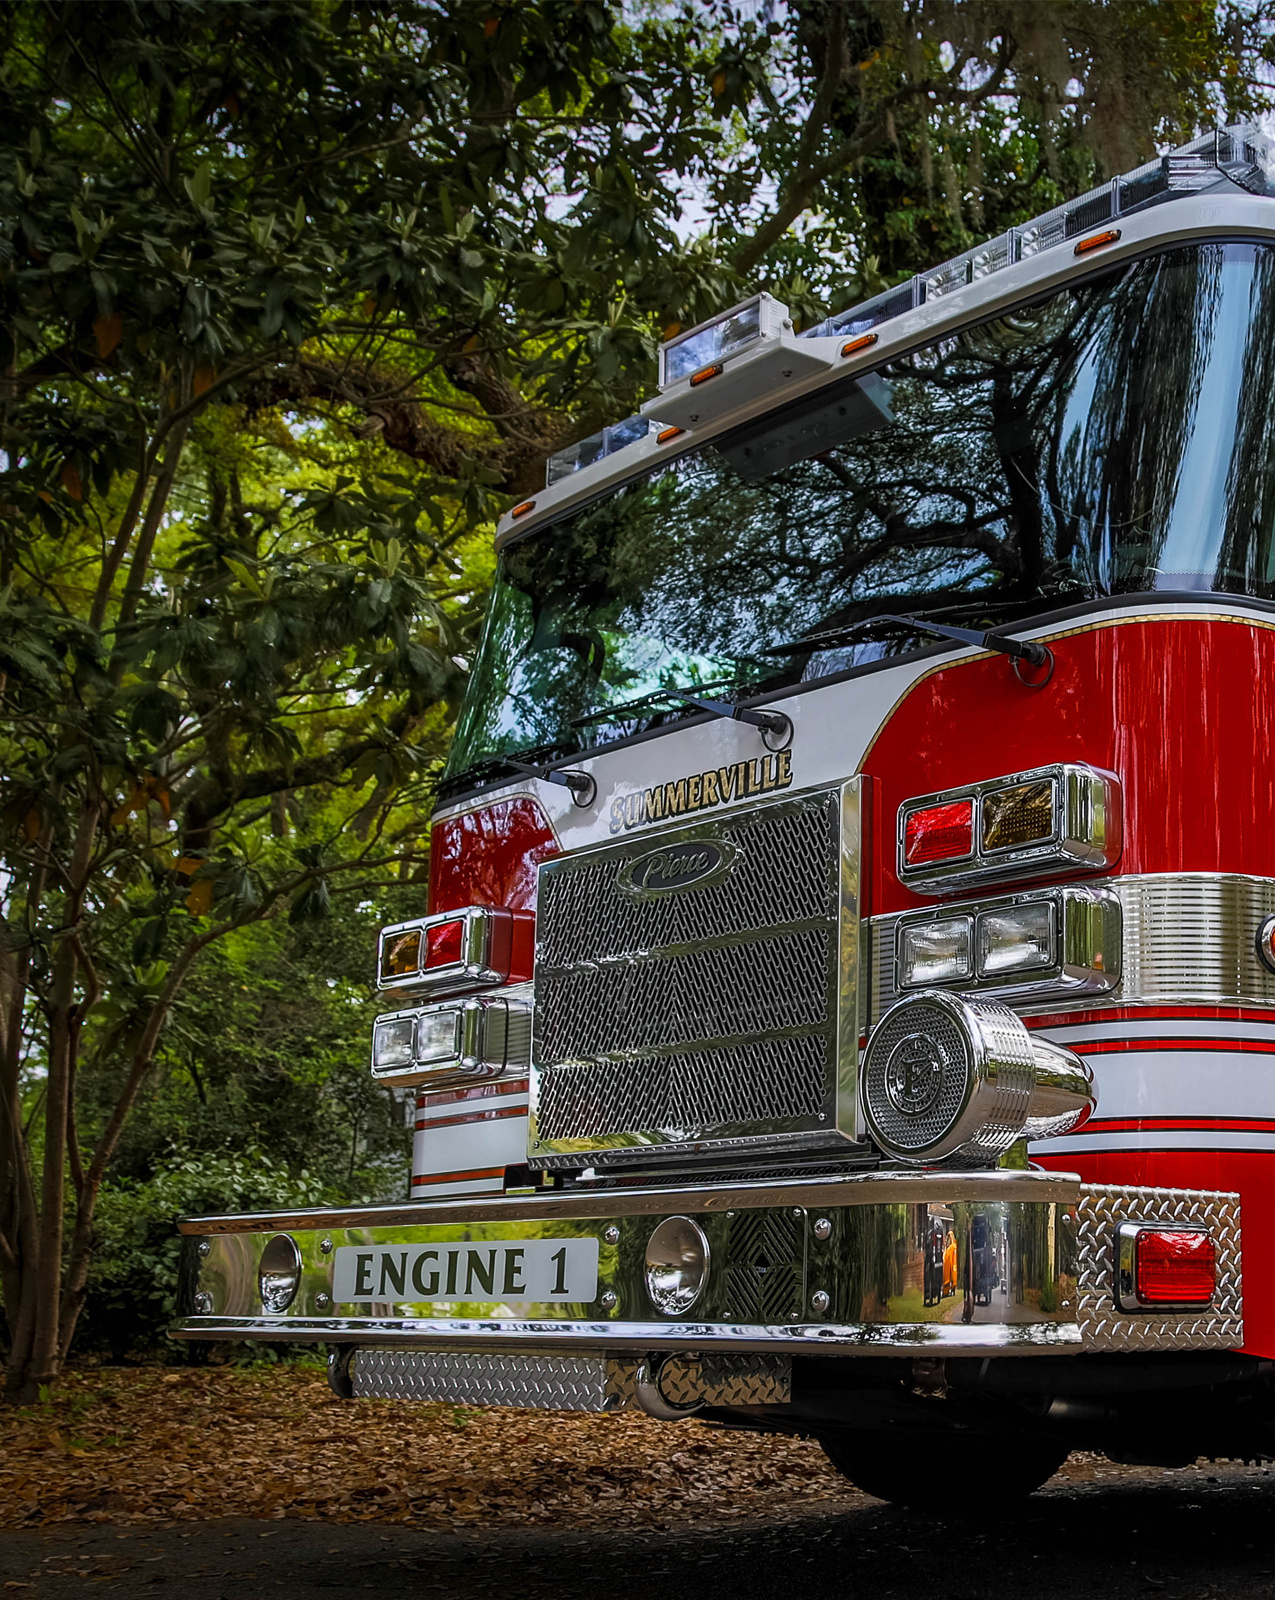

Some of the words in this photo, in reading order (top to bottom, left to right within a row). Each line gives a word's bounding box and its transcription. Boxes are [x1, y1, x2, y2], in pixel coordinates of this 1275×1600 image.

[608, 749, 794, 834] SUMMERVILLE
[642, 851, 710, 888] Pierce
[354, 1248, 527, 1297] ENGINE
[550, 1247, 570, 1295] 1
